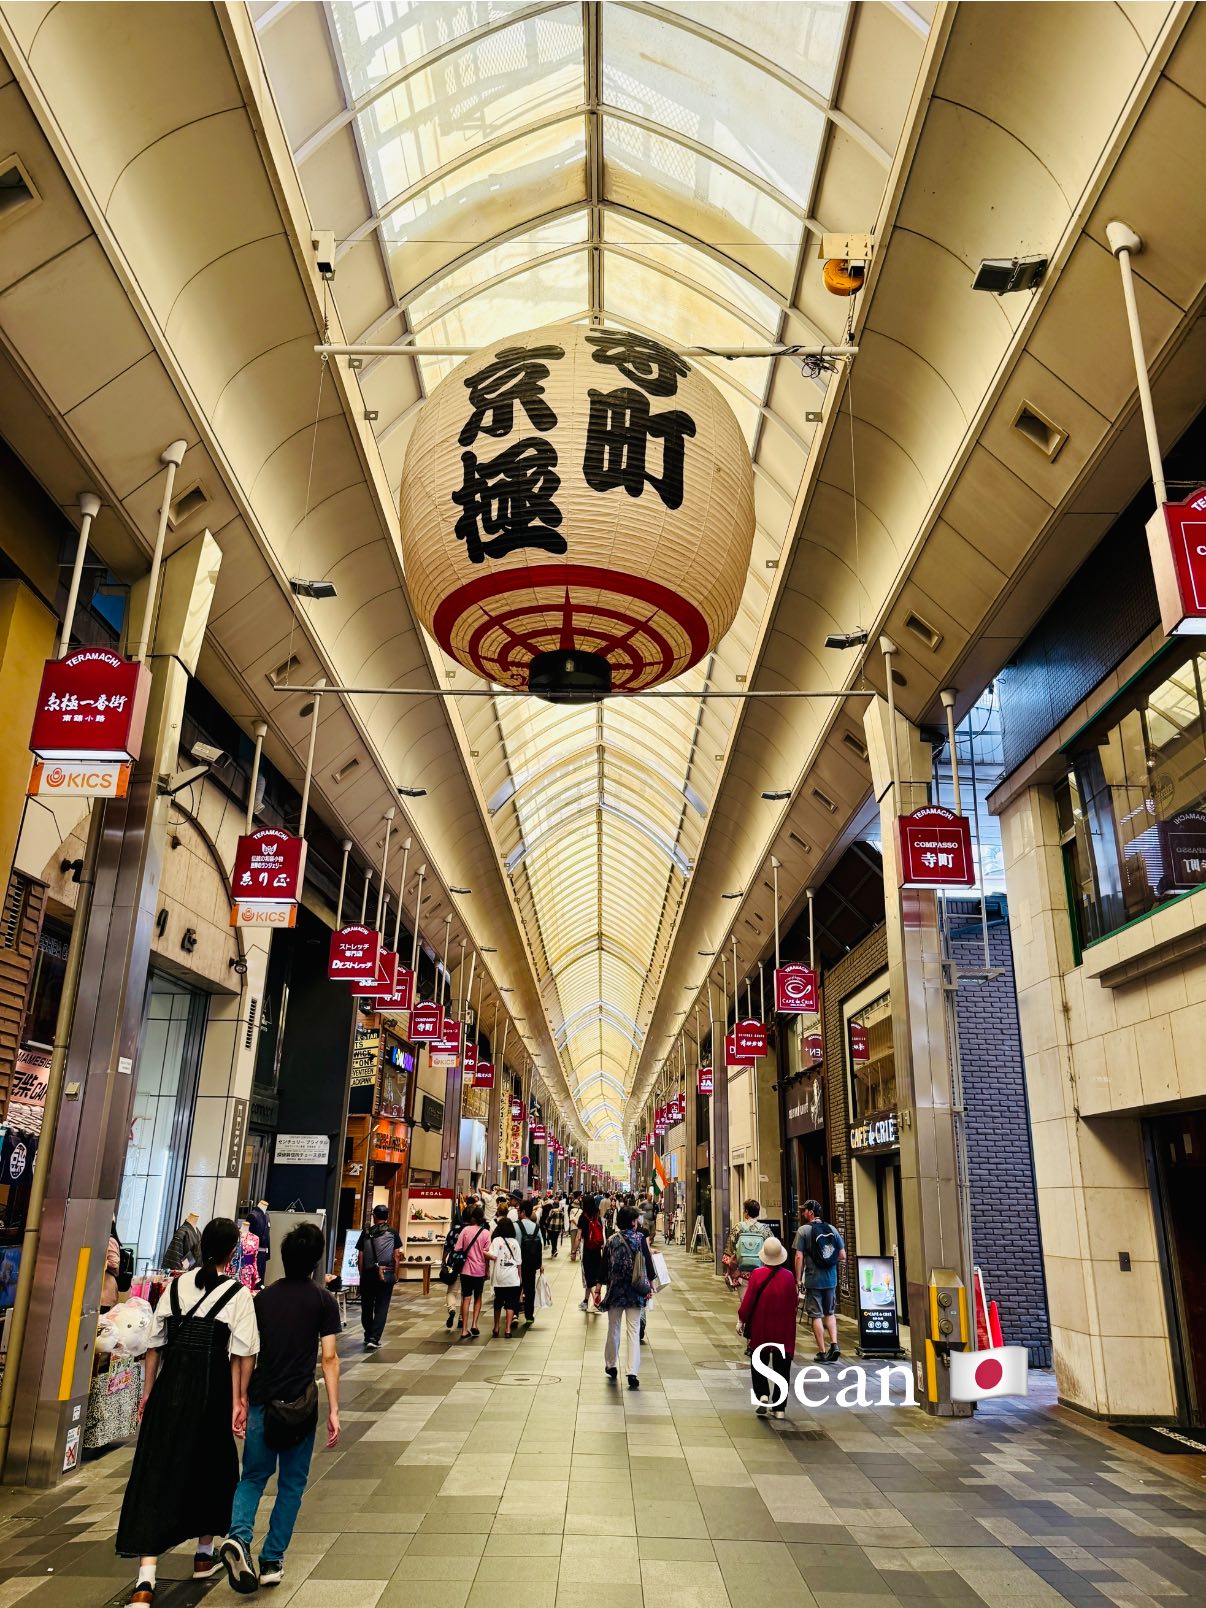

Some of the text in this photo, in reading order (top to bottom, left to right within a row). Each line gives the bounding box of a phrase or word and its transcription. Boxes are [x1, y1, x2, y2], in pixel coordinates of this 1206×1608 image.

[451, 345, 568, 563] 京極
[65, 652, 121, 668] TERAMACHI
[44, 692, 128, 712] 京極一番街
[67, 773, 113, 789] KICS
[912, 807, 954, 820] TERAMACHI
[252, 829, 289, 841] TERAMACHI
[914, 841, 958, 849] COMPASSO
[920, 851, 954, 868] 寺町
[255, 911, 287, 923] KICS
